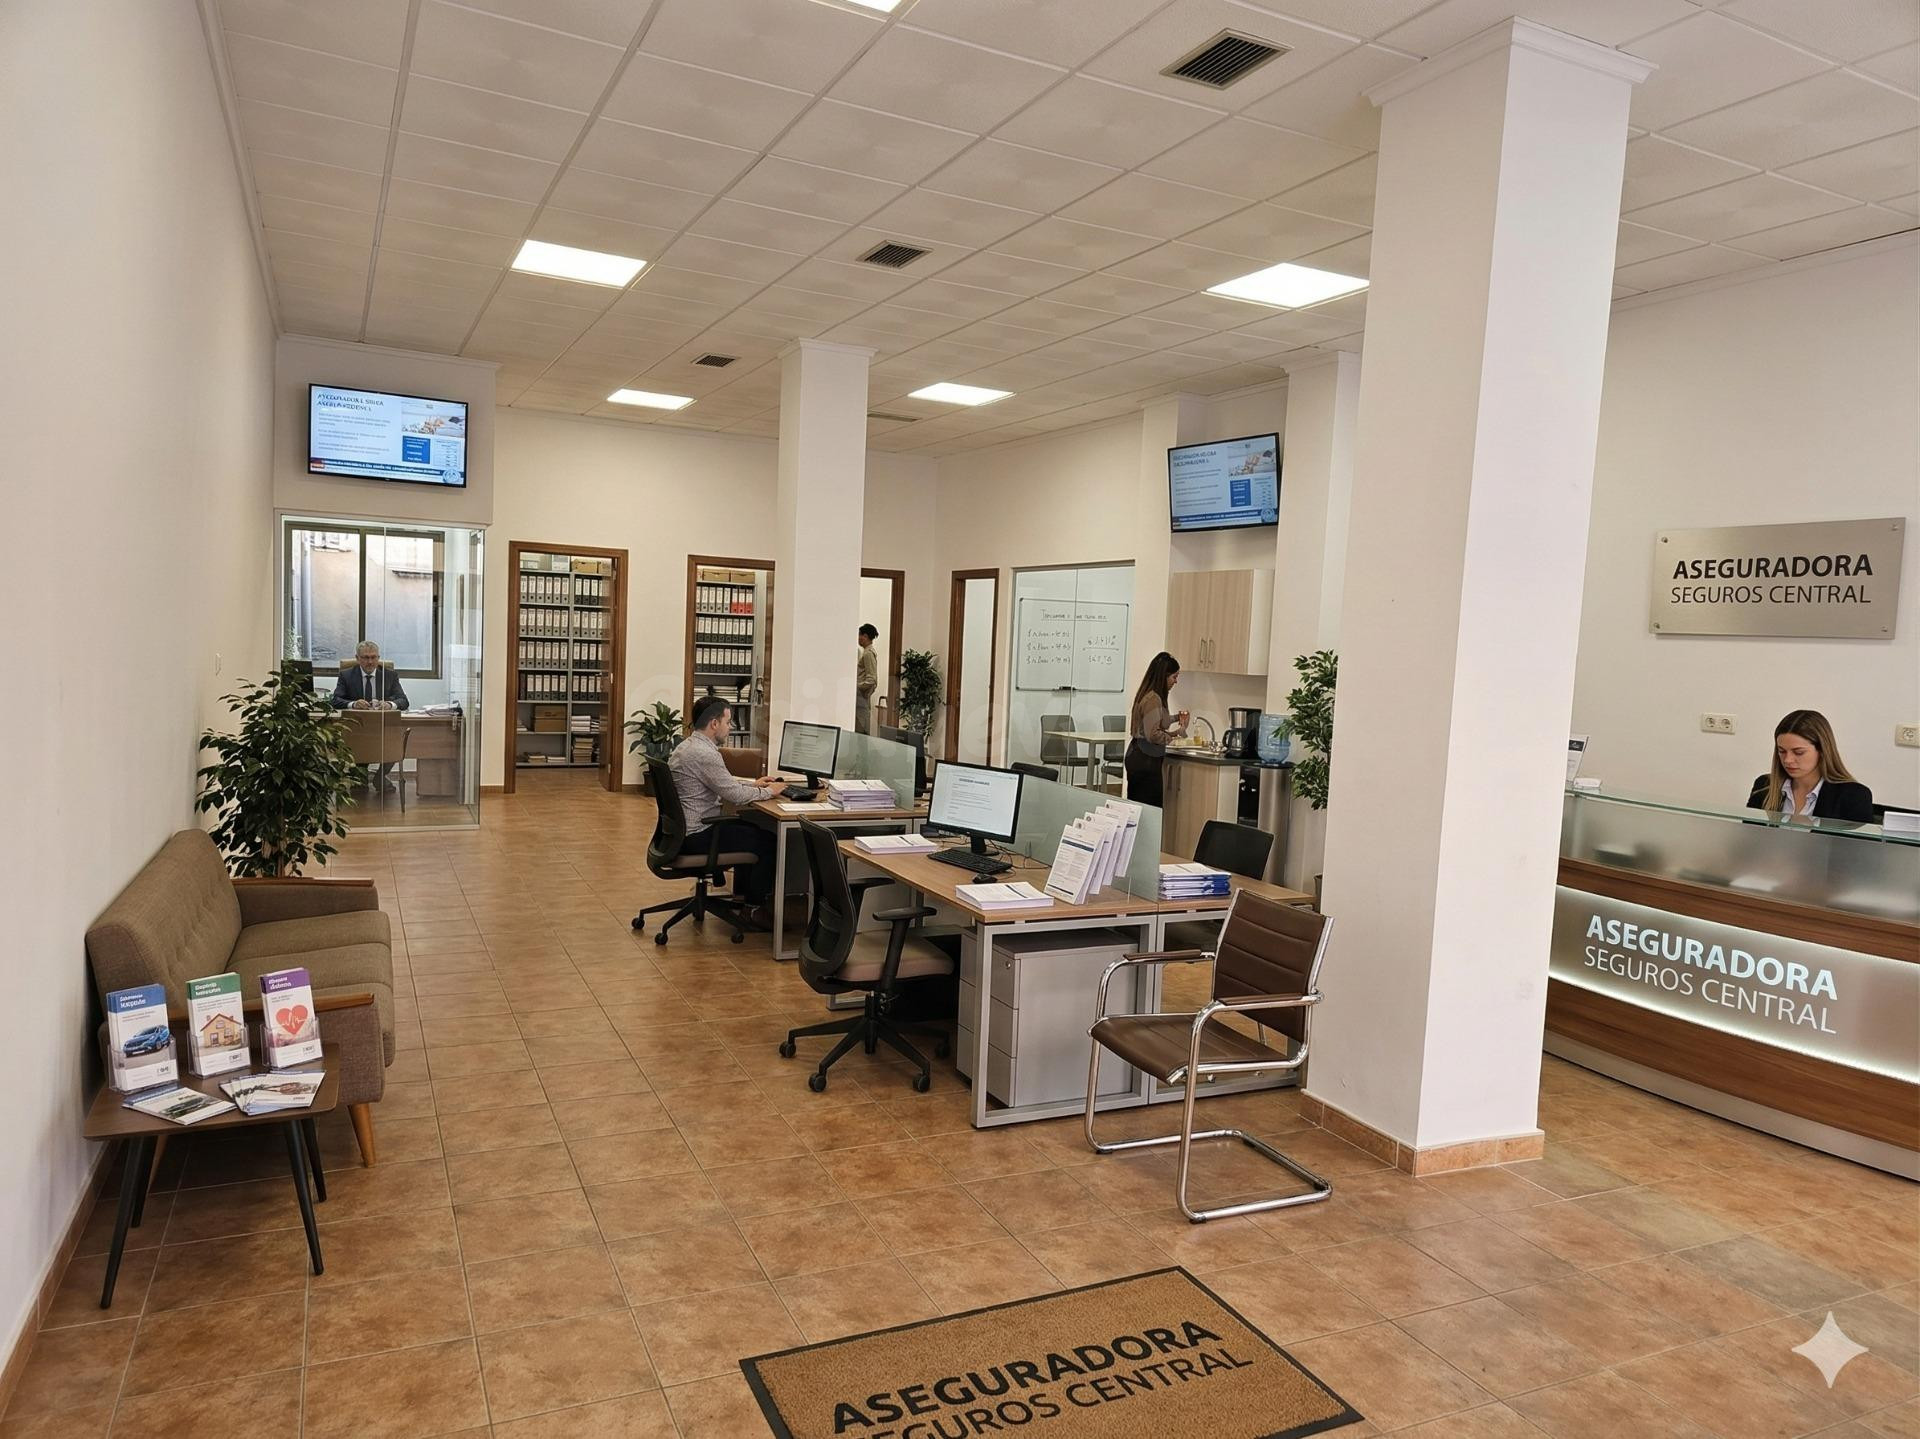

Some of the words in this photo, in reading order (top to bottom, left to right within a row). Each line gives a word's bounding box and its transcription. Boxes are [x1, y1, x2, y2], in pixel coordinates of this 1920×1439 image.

[1671, 585, 1763, 604] SEGUROS
[1769, 584, 1871, 604] CENTRAL
[1673, 554, 1873, 579] ASEGURADORA
[1584, 945, 1694, 996] SEGUROS
[1701, 978, 1838, 1034] CENTRAL
[1586, 914, 1838, 1001] ASEGURADORA
[834, 1320, 1223, 1434] ASEGURADORA
[853, 1393, 1061, 1439] GUROS
[1065, 1347, 1254, 1407] CENTRAL
